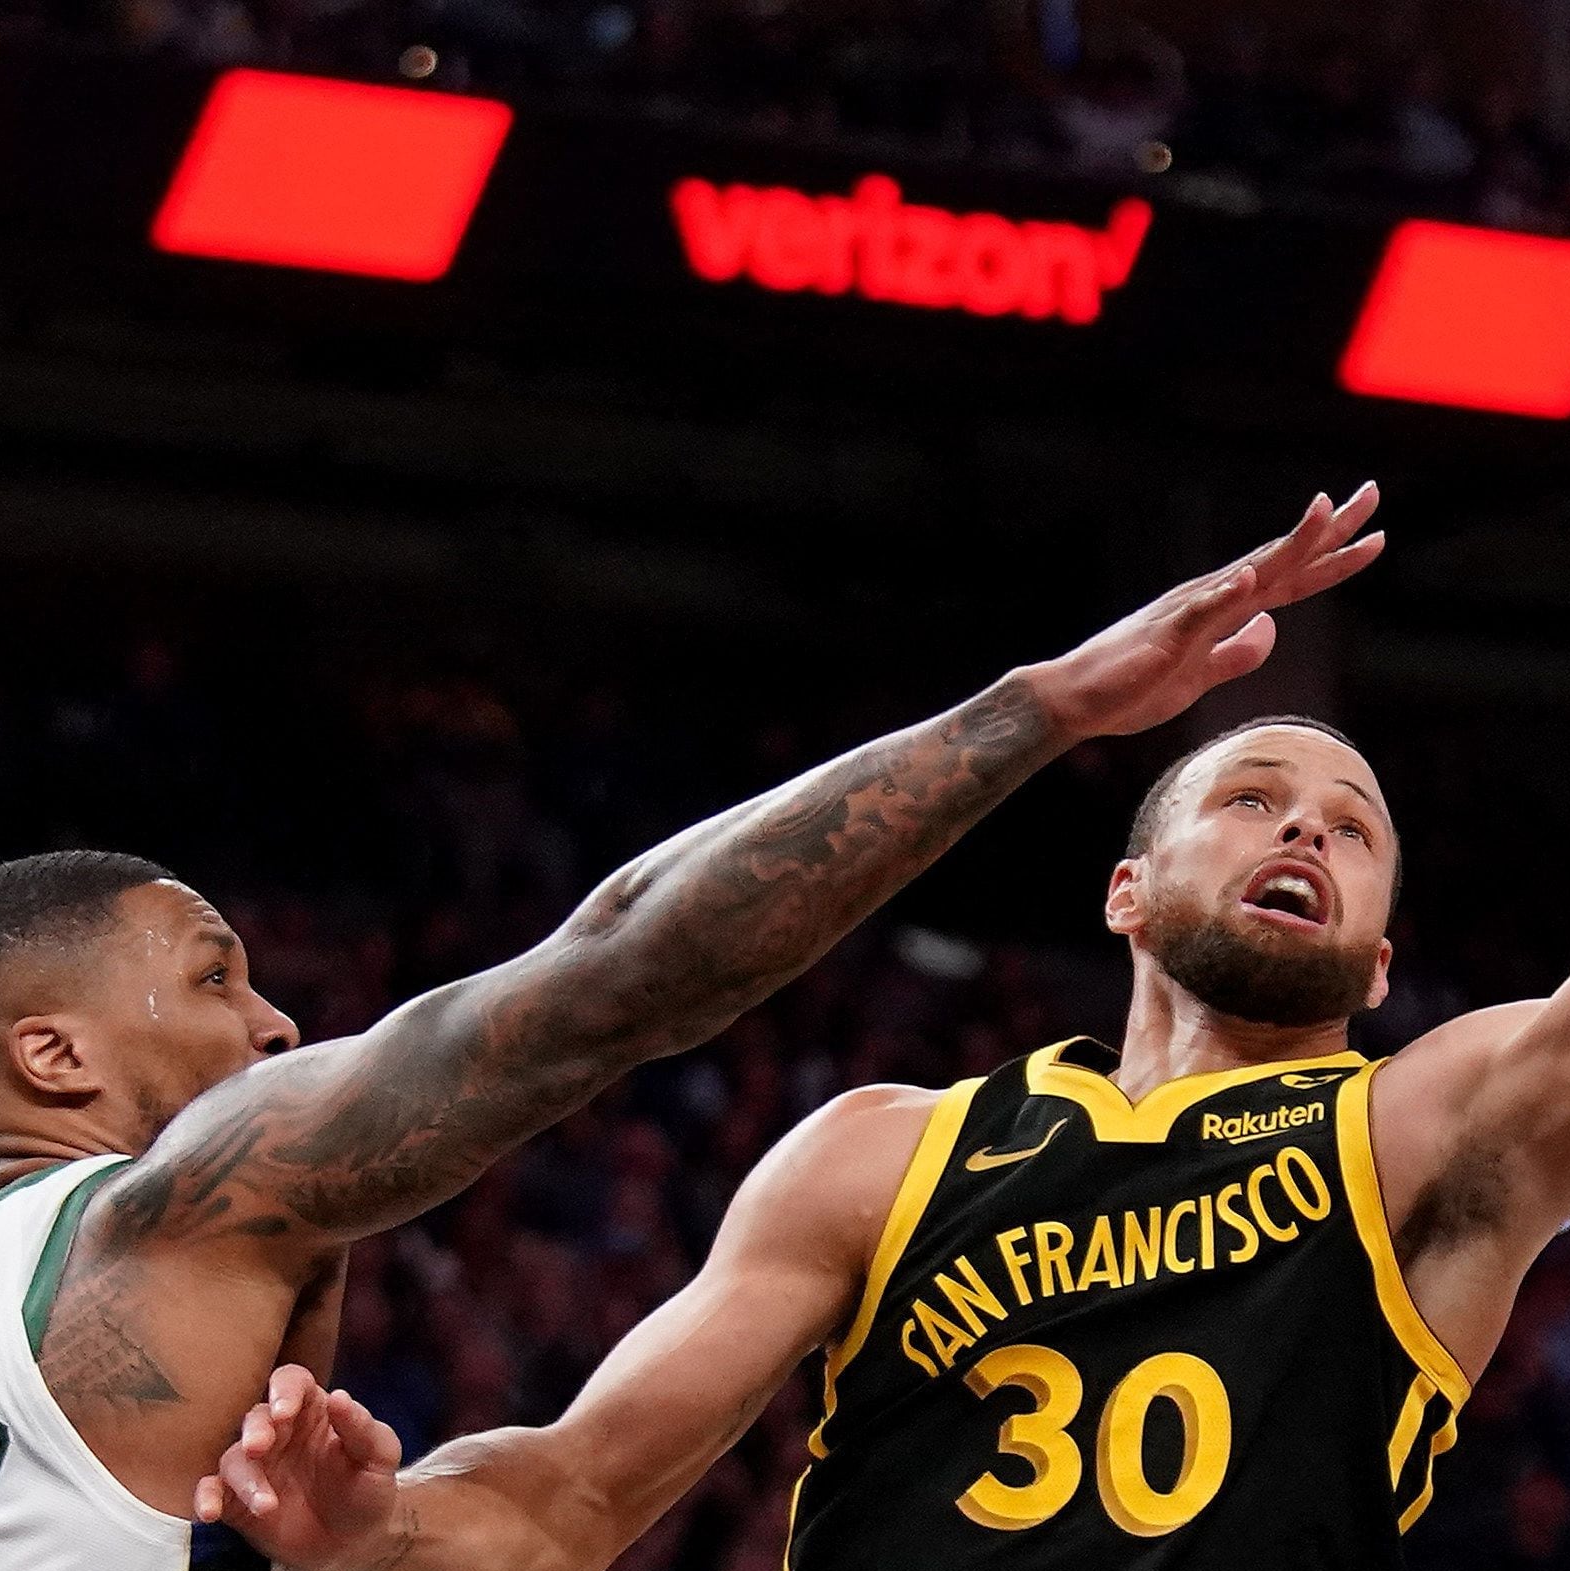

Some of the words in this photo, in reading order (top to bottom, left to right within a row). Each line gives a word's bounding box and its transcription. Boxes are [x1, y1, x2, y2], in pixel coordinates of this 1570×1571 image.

[1202, 1101, 1325, 1141] Rakuten
[901, 1255, 1006, 1378] SAN
[995, 1146, 1332, 1306] FRANCISCO
[954, 1343, 1232, 1537] 30
